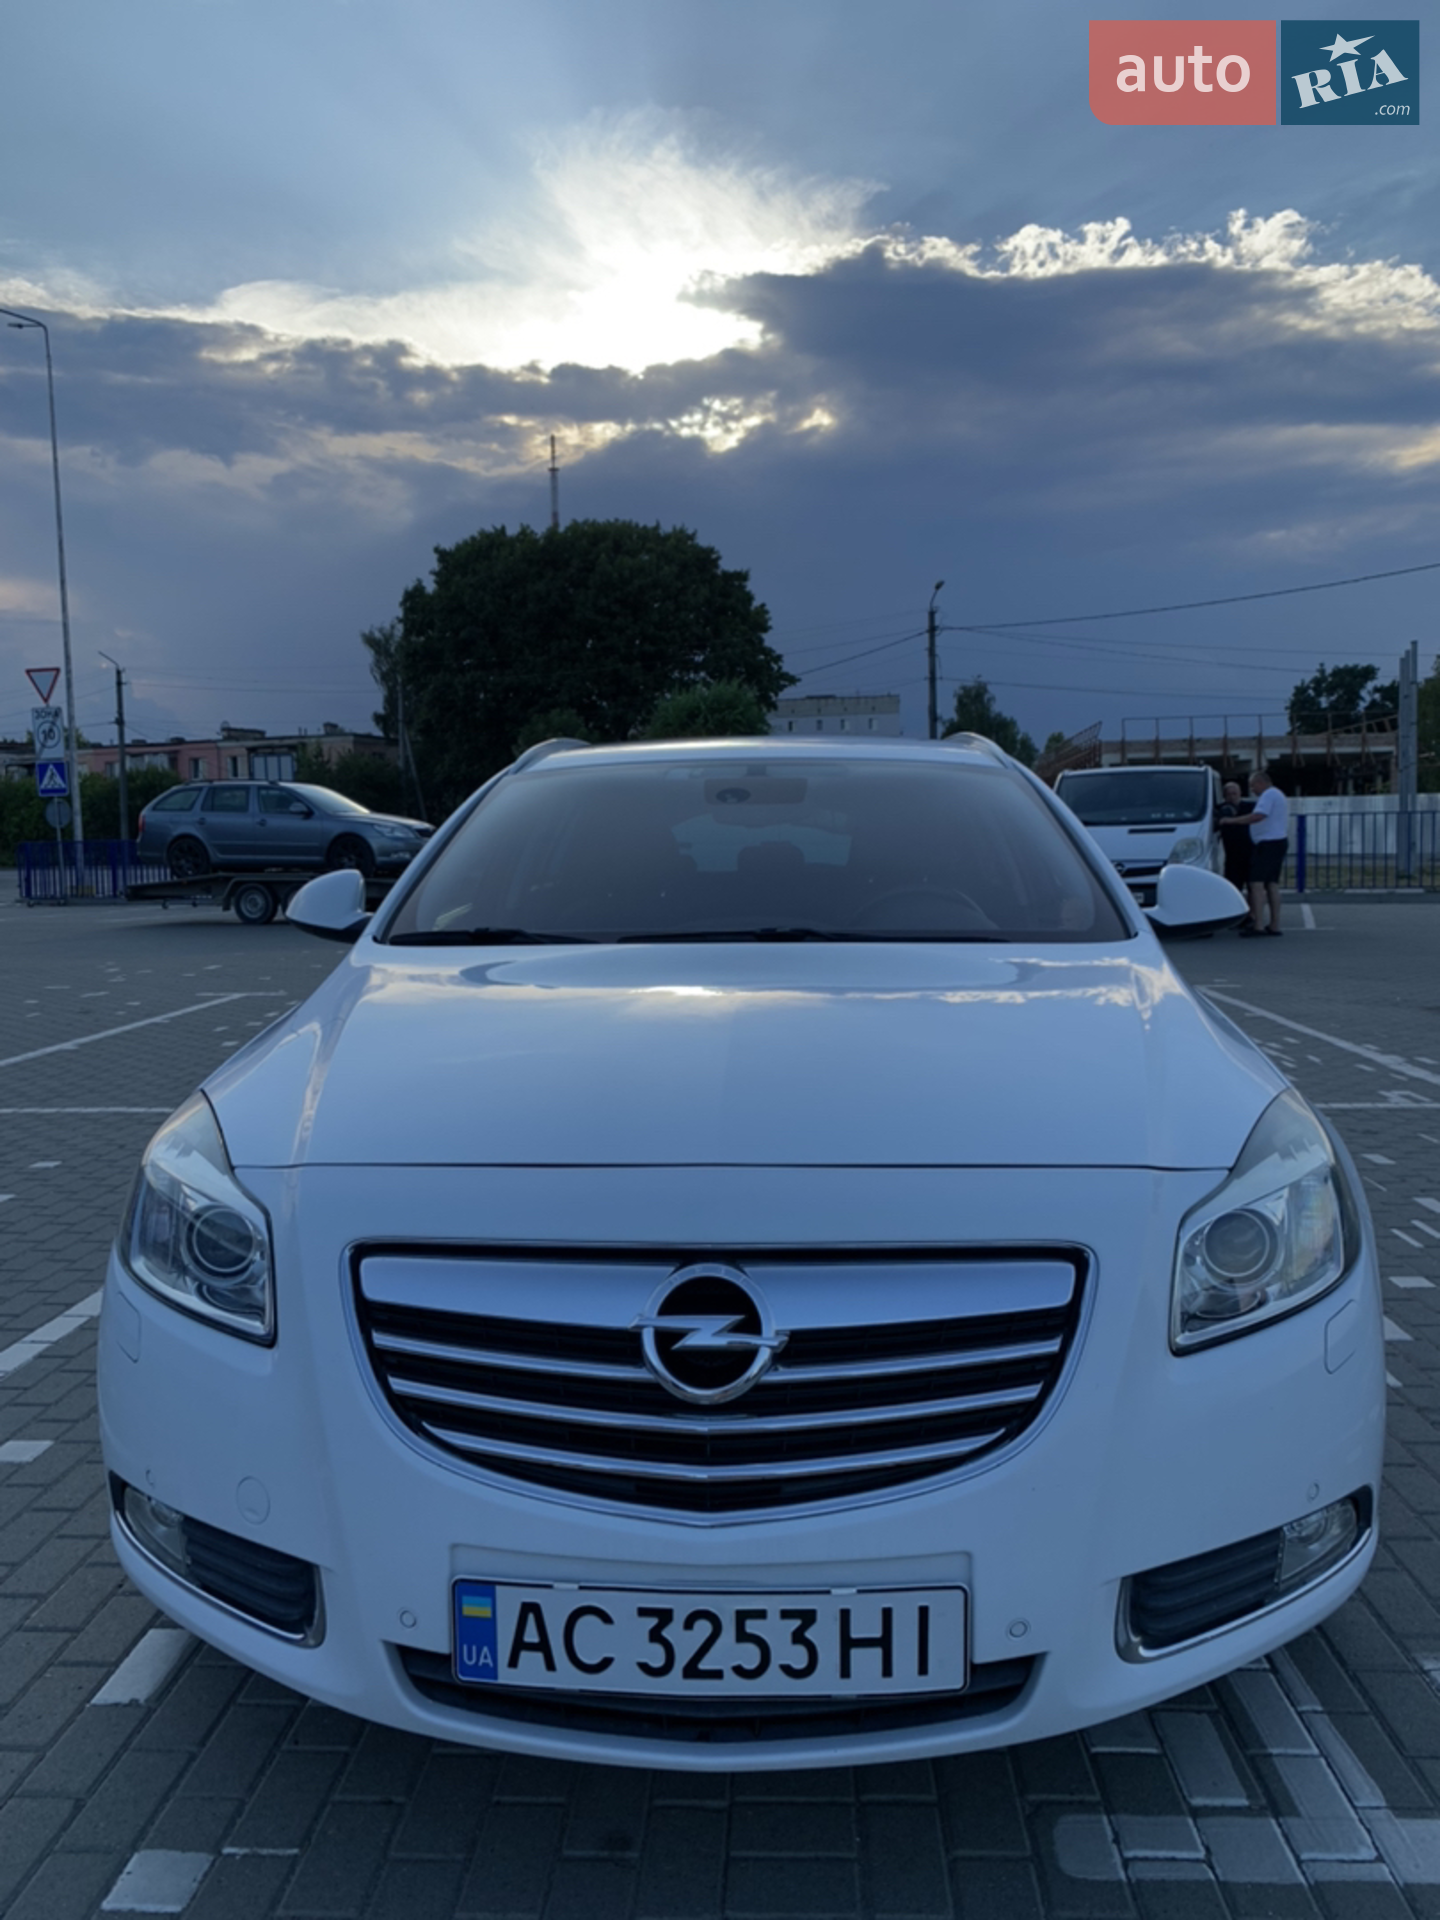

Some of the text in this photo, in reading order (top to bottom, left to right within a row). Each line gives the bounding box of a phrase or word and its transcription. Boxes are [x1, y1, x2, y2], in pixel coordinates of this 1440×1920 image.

[462, 1644, 494, 1668] UA
[506, 1601, 930, 1680] AC 3253 HI
